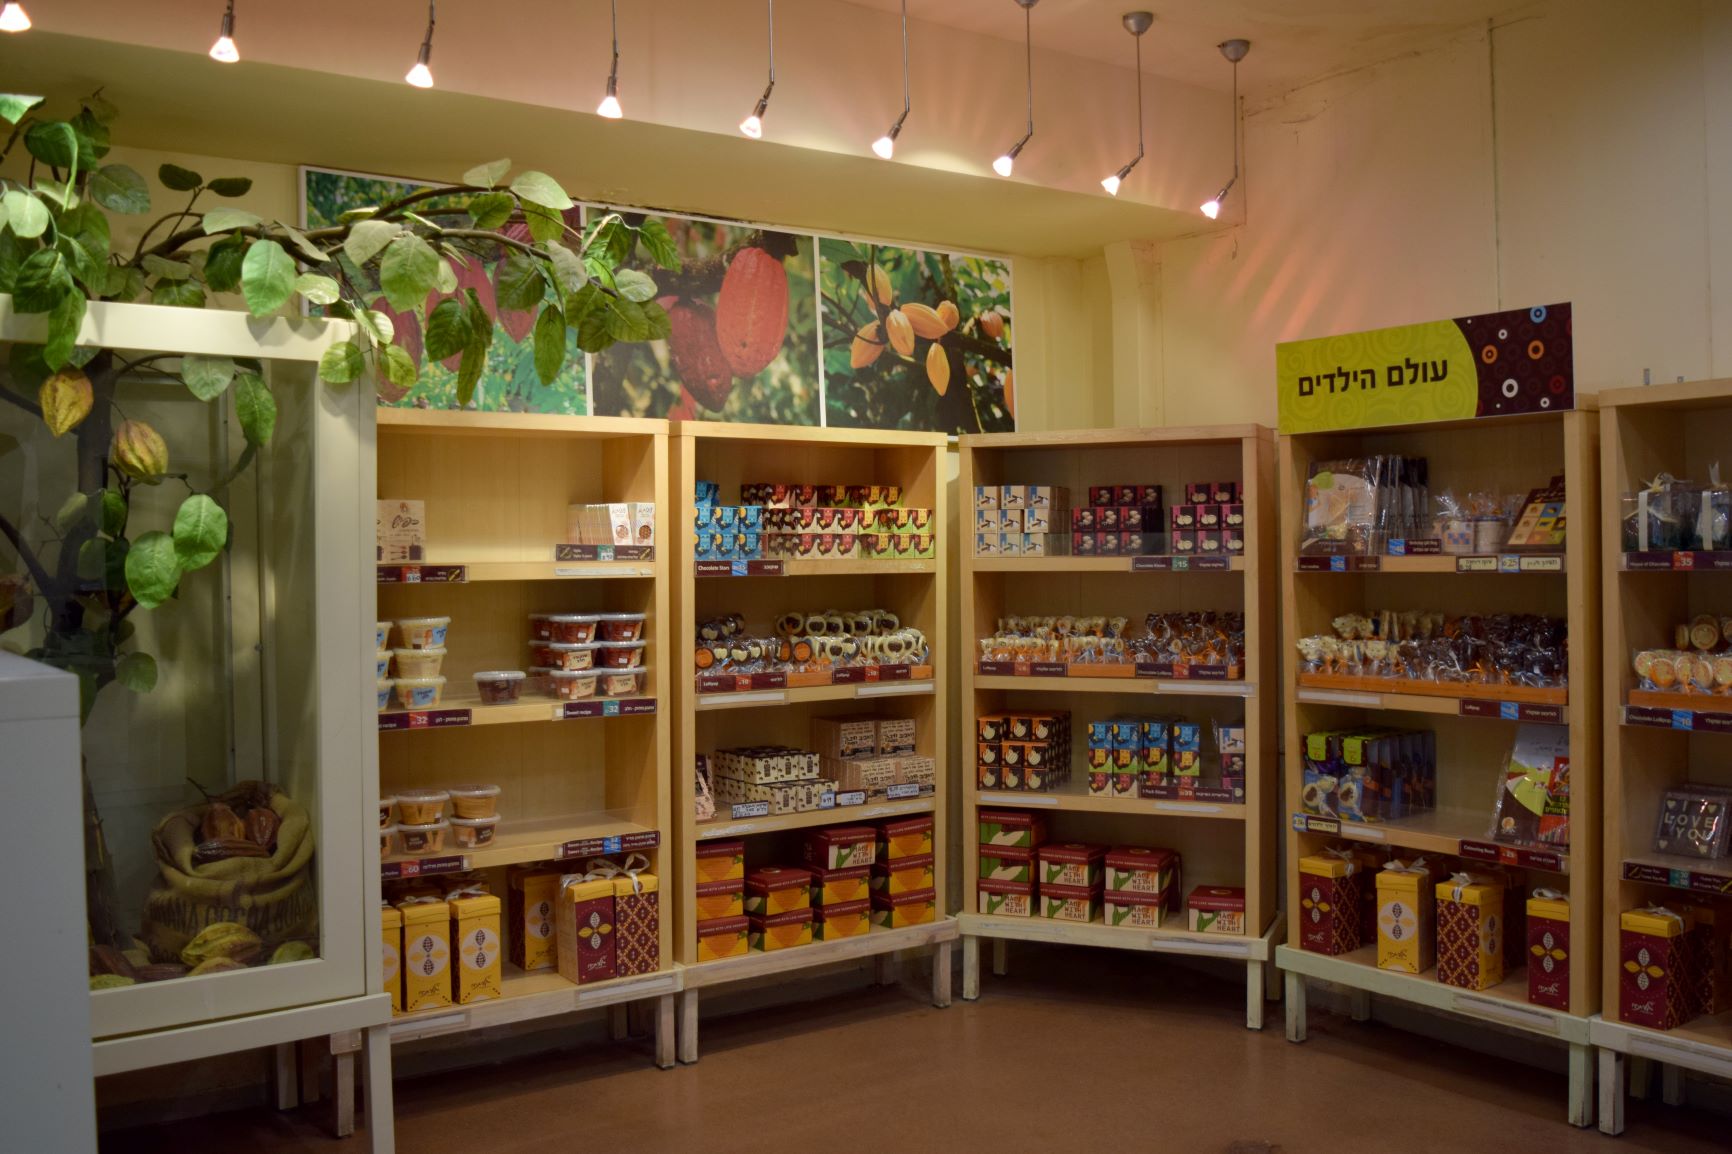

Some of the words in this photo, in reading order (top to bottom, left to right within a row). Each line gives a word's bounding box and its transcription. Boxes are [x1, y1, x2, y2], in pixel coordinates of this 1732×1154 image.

[1387, 358, 1448, 388] עולם
[1298, 366, 1376, 397] הילדים
[1179, 560, 1188, 568] 15
[1681, 558, 1693, 567] 35
[609, 705, 619, 713] 32
[416, 716, 428, 724] 32
[1682, 800, 1688, 812] I
[1664, 812, 1714, 829] LOVE
[1676, 827, 1714, 841] YOU
[408, 865, 419, 873] 60
